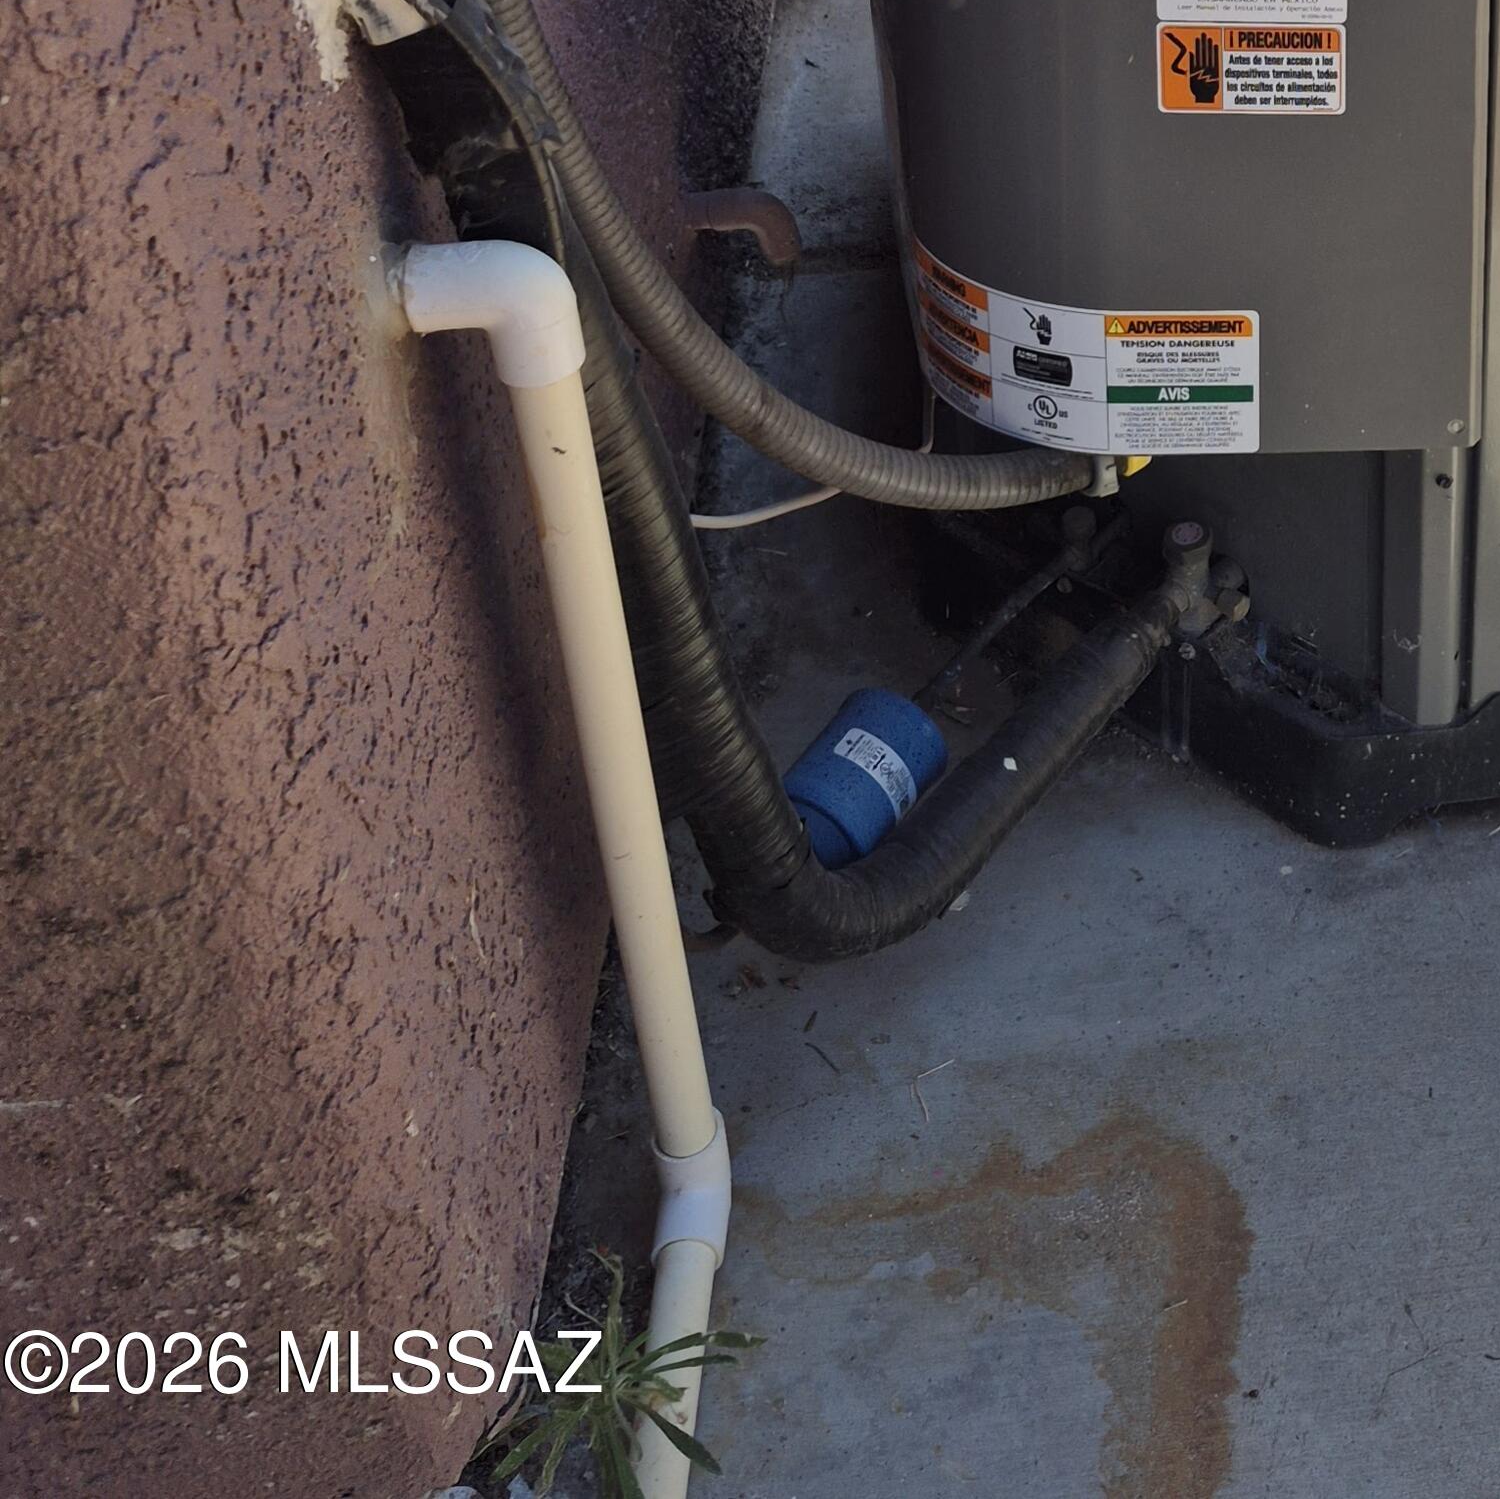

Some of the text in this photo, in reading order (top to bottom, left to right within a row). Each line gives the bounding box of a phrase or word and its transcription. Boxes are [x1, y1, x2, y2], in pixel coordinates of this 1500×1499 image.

[1238, 31, 1323, 49] PRECAUCION
[1229, 55, 1333, 66] Antes de tener acceso a los
[1225, 68, 1271, 79] dispositivos
[1317, 70, 1338, 79] todos
[1227, 82, 1336, 93] los circuitos de alimentación
[1234, 96, 1257, 105] deben
[1259, 97, 1272, 105] ser
[1127, 320, 1244, 334] ADVERTISSEMENT
[1120, 340, 1235, 348] TENSION DANGEREUSE
[1158, 388, 1190, 401] AVIS
